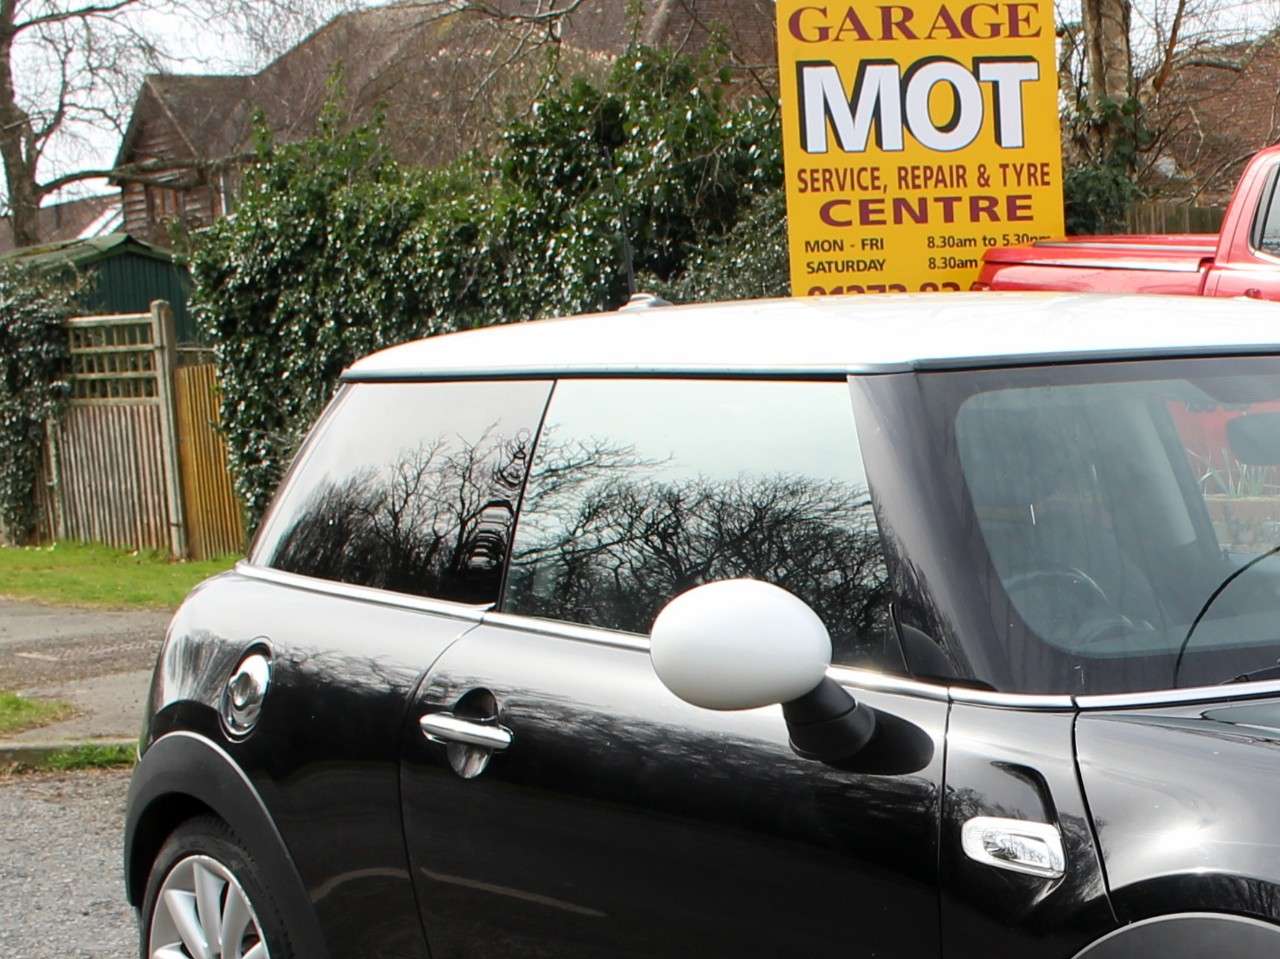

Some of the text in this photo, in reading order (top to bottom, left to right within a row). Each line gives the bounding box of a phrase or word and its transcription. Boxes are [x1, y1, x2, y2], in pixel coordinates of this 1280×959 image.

[788, 2, 1042, 43] GARAGE
[795, 55, 1039, 153] MOT
[797, 162, 1051, 194] SERVICE, REPAIR & TYRE
[818, 194, 1034, 227] CENTRE
[804, 239, 844, 253] MON
[861, 237, 885, 251] FRI
[927, 235, 977, 249] 8.30am
[982, 234, 997, 247] to
[806, 256, 978, 274] SATURDAY 8.30am
